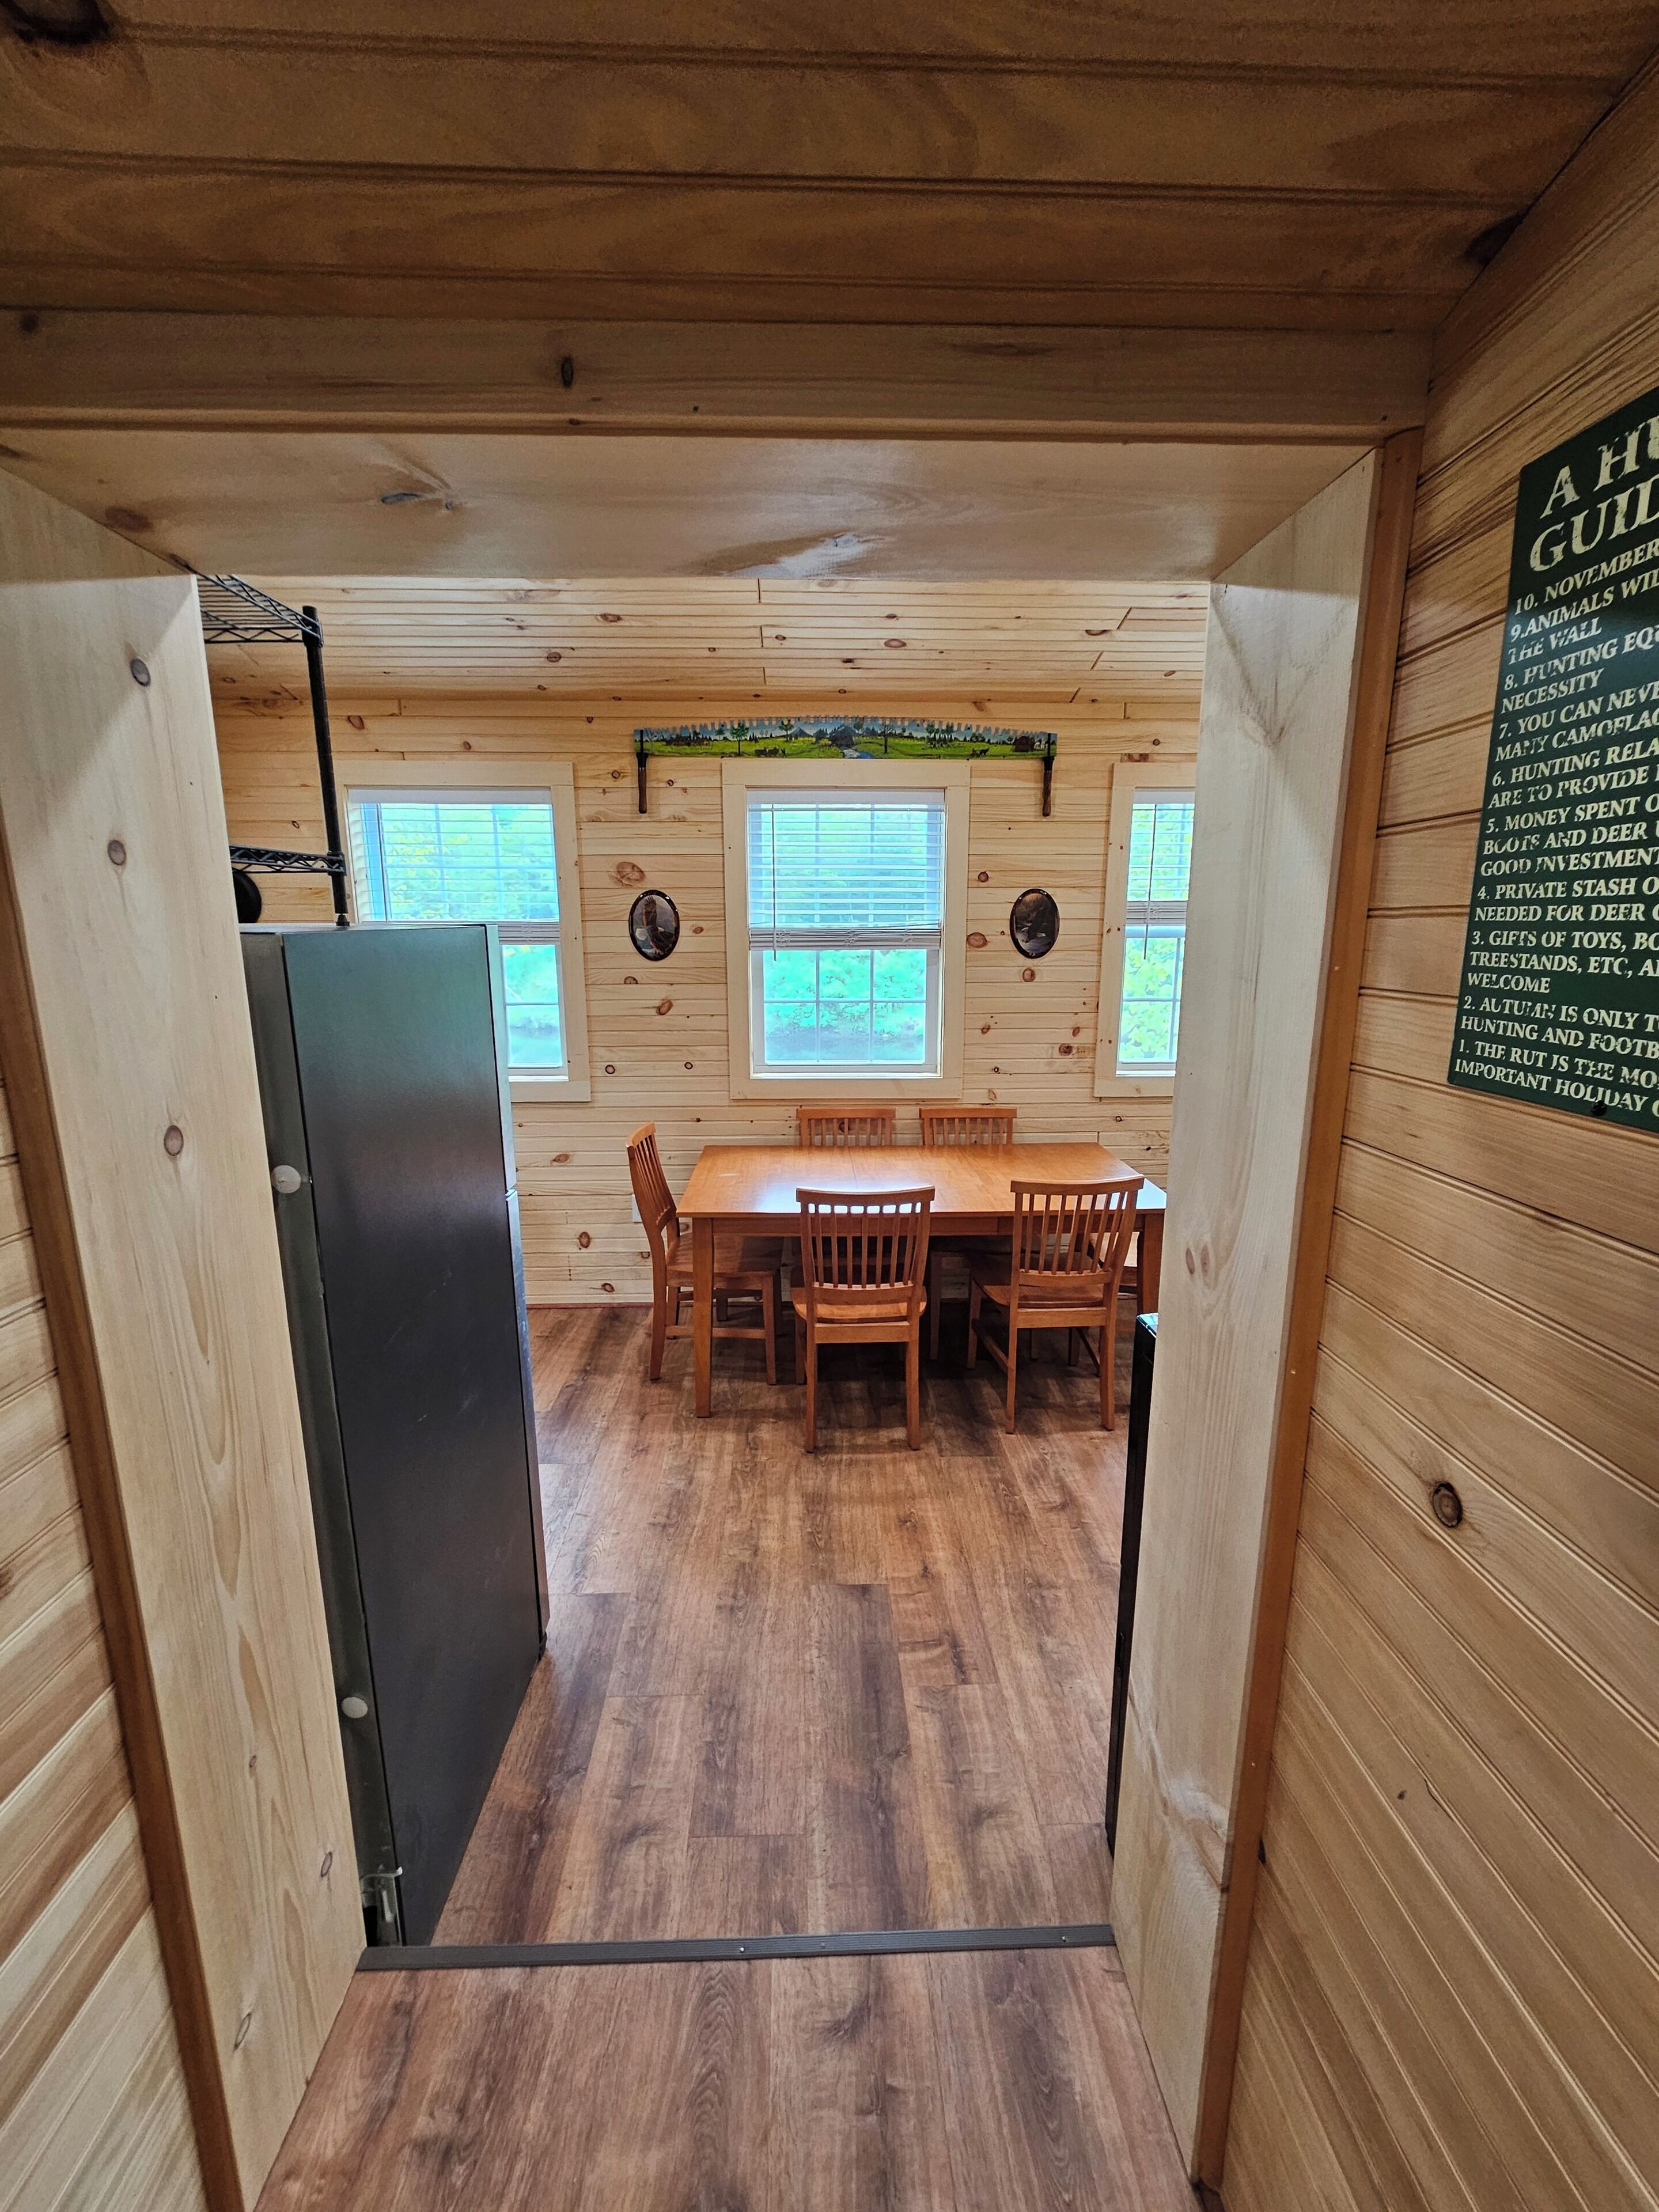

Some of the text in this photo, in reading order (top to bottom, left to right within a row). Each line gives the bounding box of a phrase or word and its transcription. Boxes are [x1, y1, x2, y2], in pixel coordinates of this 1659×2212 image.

[1539, 465, 1580, 519] A
[1515, 538, 1659, 615] 10. NOVEMBER
[1508, 617, 1603, 665] THE WALL
[1504, 674, 1518, 691] 8.
[1522, 638, 1619, 685] HUNTING
[1501, 668, 1604, 714] NECESSITY
[1499, 724, 1512, 740] 7.
[1518, 709, 1556, 735] YOU
[1559, 697, 1604, 723] CAN
[1495, 734, 1550, 762] MANY
[1492, 771, 1505, 787] 6.
[1510, 750, 1601, 784] HUNTING
[1487, 789, 1522, 809] ARE
[1527, 783, 1552, 803] TO
[1555, 766, 1649, 798] PROVIDE
[1486, 818, 1499, 834] 5.
[1504, 806, 1571, 831] MONEY
[1574, 796, 1641, 821] SPENT
[1483, 834, 1540, 855] BOOTS
[1543, 829, 1586, 849] AND
[1590, 821, 1648, 845] DEER
[1480, 858, 1531, 877] GOOD
[1495, 881, 1567, 900] PRIVATE
[1571, 877, 1638, 897] STASH
[1474, 905, 1542, 922] NEEDED
[1545, 904, 1585, 922] FOR
[1589, 903, 1646, 921] DEER
[1471, 931, 1484, 945] 3.
[1488, 931, 1537, 946] GIFTS
[1541, 931, 1567, 948] OF
[1571, 931, 1627, 953] TOYS,
[1467, 972, 1551, 994] WELCOME
[1470, 951, 1659, 978] TREESTANDS, ETC, A
[1461, 1016, 1538, 1040] HUNTING
[1541, 1027, 1584, 1047] AND
[1463, 996, 1659, 1032] 2. AUTUMN IS ONLY T
[1460, 1039, 1659, 1089] 1. THE RUT IS THE MO
[1455, 1059, 1551, 1091] IMPORTANT
[1554, 1079, 1649, 1111] HOLIDAY
